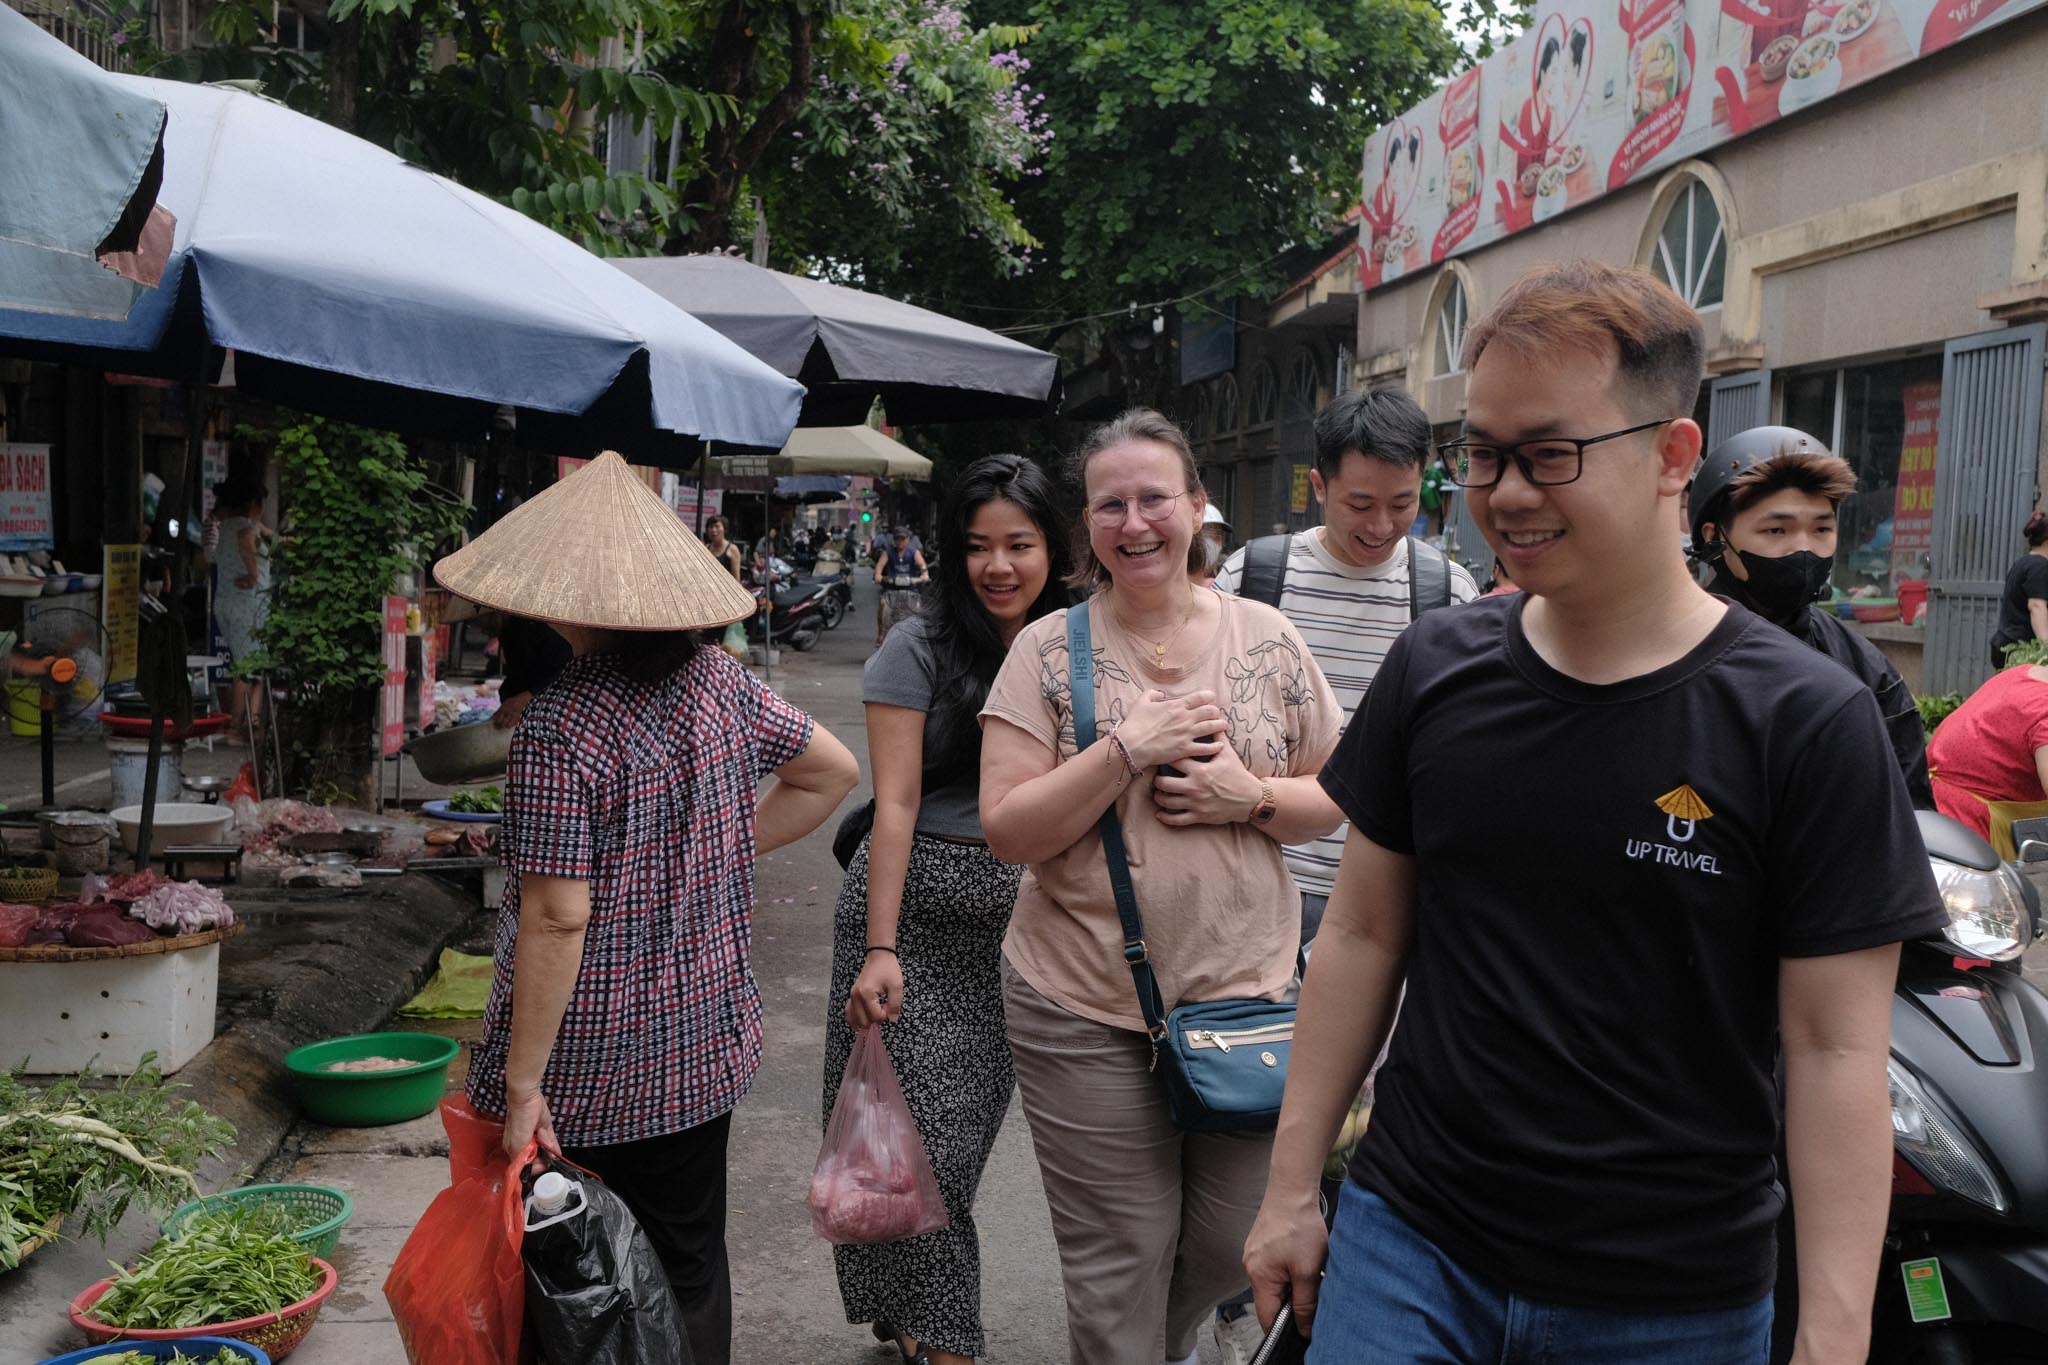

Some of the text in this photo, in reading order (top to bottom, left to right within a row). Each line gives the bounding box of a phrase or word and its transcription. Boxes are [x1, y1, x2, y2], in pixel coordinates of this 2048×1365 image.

[1073, 628, 1088, 680] JIELSHI
[1626, 838, 1722, 875] UP TRAVEL
